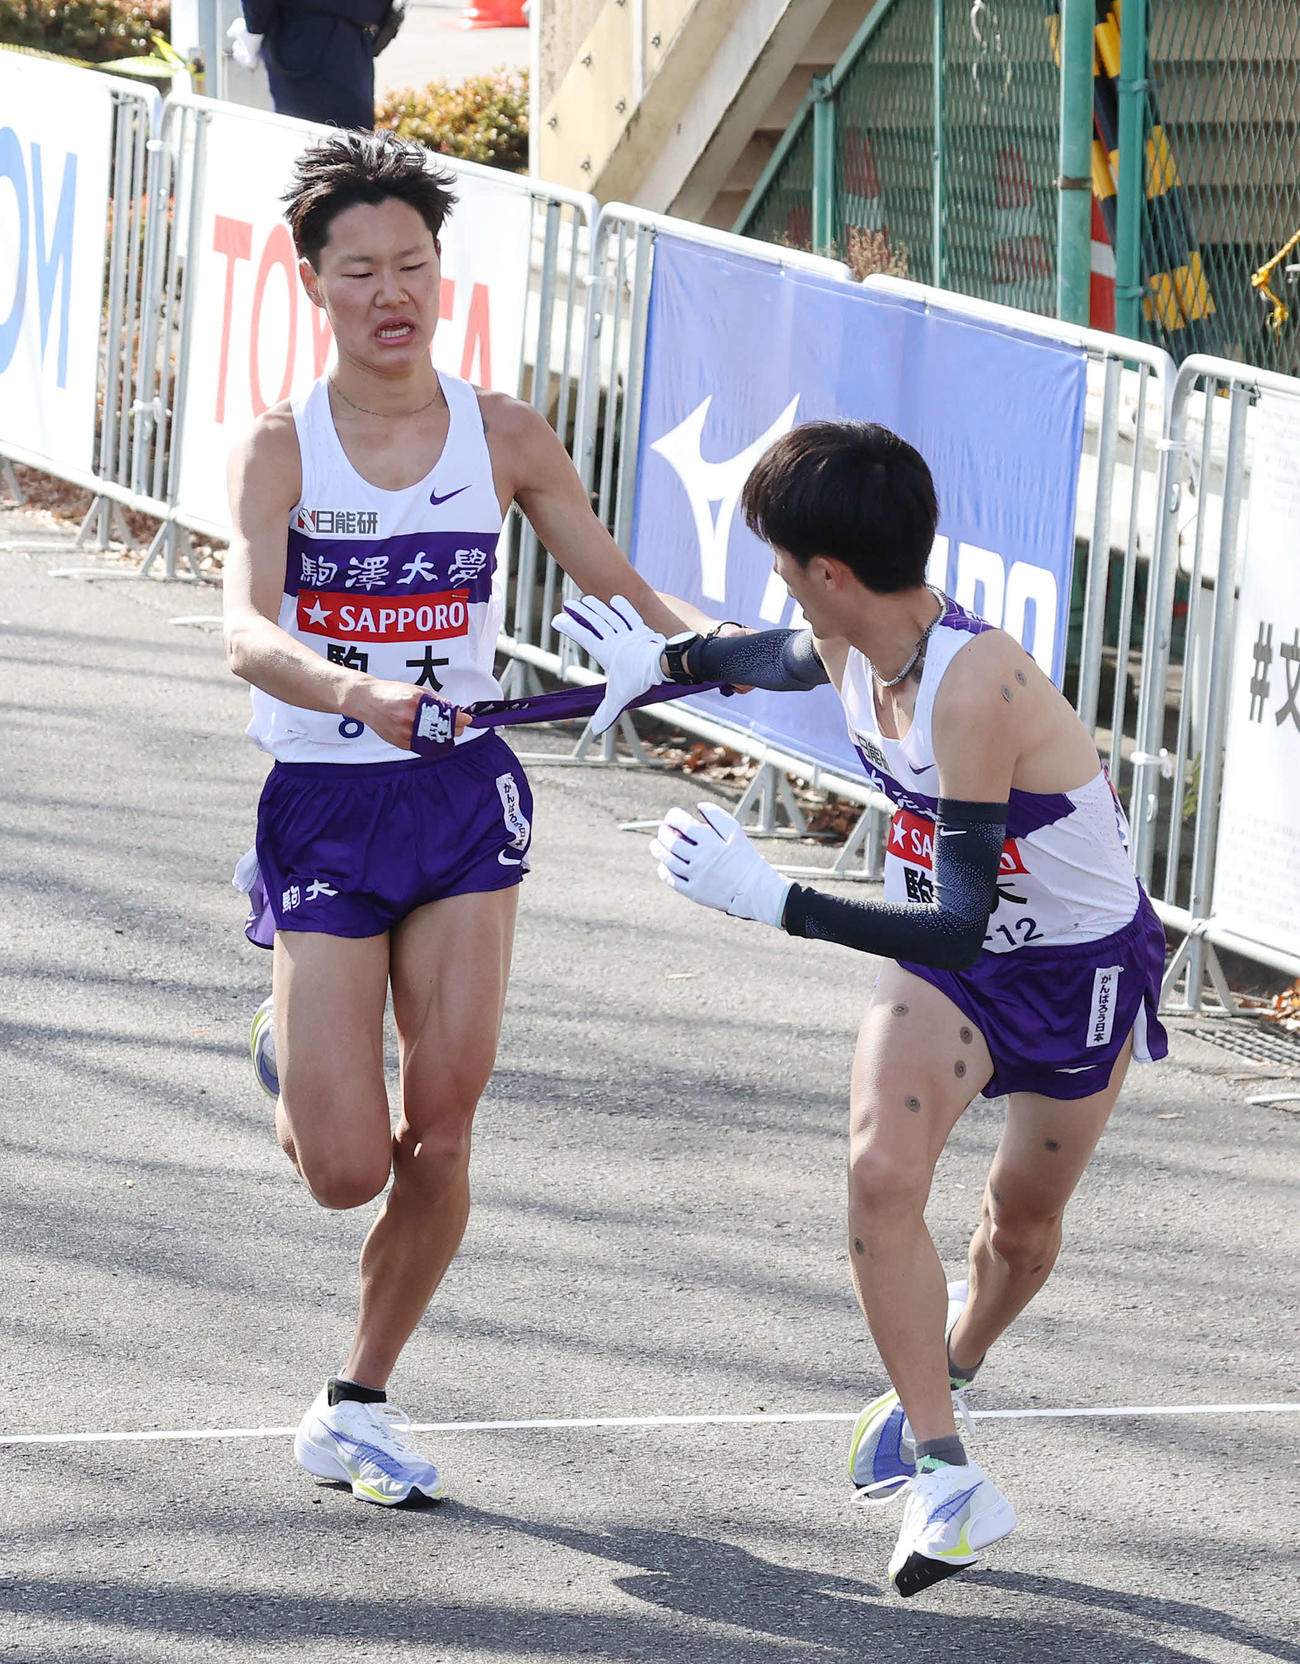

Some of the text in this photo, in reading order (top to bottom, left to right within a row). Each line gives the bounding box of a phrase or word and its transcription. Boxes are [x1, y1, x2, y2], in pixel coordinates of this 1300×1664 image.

[213, 214, 492, 424] TOA
[338, 600, 465, 633] SAPPORO
[1093, 974, 1112, 1042] がんばろう日本
